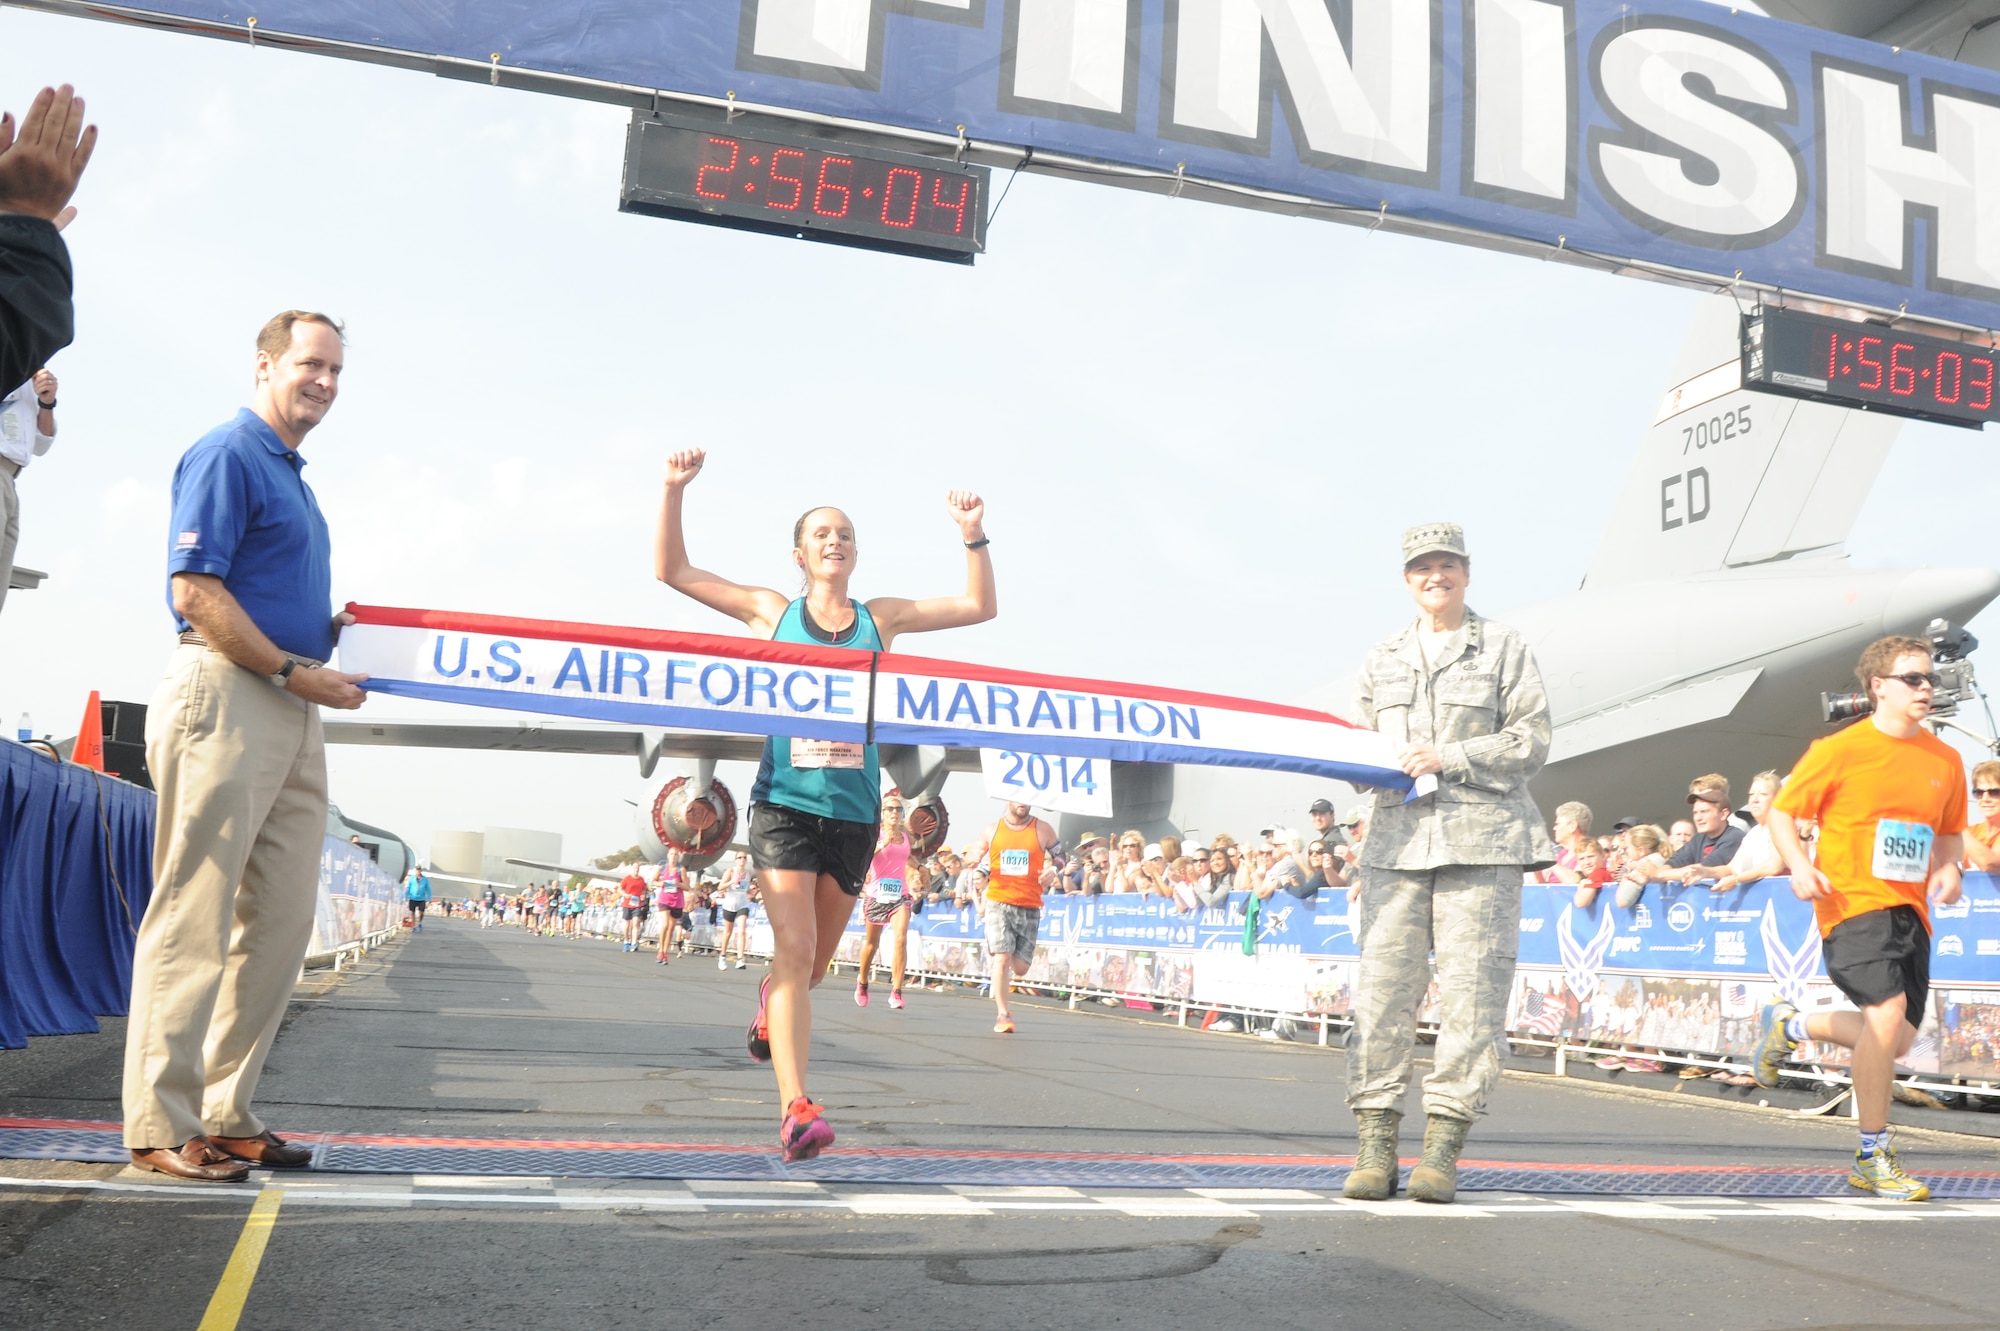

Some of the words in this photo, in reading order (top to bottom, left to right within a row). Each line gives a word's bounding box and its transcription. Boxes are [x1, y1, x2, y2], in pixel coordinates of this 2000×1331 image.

[1682, 404, 1752, 456] 70025
[1661, 466, 1711, 531] ED
[433, 634, 535, 684] U.S.
[552, 647, 650, 697] AIR
[665, 660, 855, 714] FORCE
[896, 677, 1201, 740] MARATHON
[999, 751, 1098, 796] 2014
[1001, 855, 1028, 867] 10378
[1883, 835, 1925, 861] 9591
[879, 882, 902, 894] 10637
